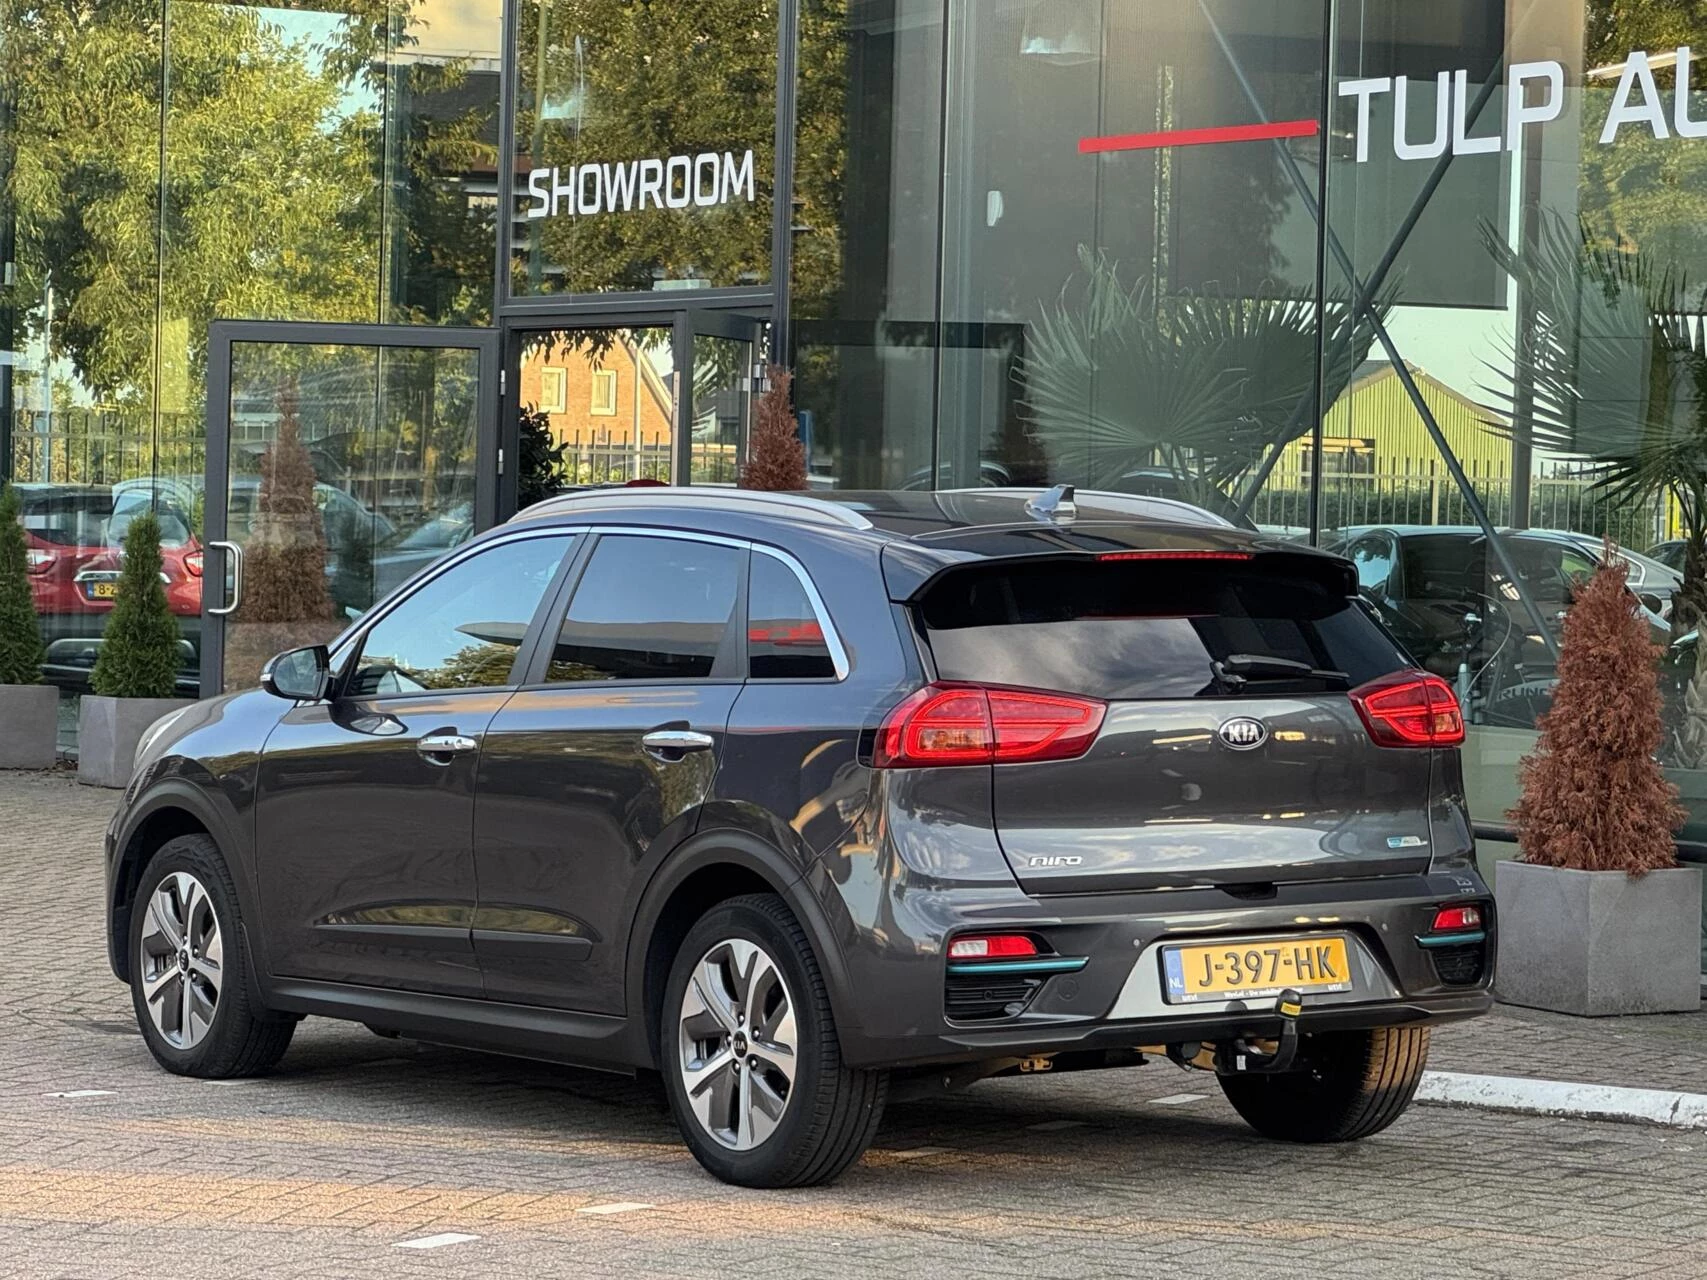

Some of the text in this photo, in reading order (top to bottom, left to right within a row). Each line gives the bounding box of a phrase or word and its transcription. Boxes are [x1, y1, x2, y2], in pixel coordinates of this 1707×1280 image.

[1338, 60, 1564, 163] TULP
[527, 149, 755, 218] SHOWROOM
[1228, 723, 1260, 742] KIA
[1169, 977, 1183, 988] NL
[1199, 946, 1337, 987] J-397-HK
